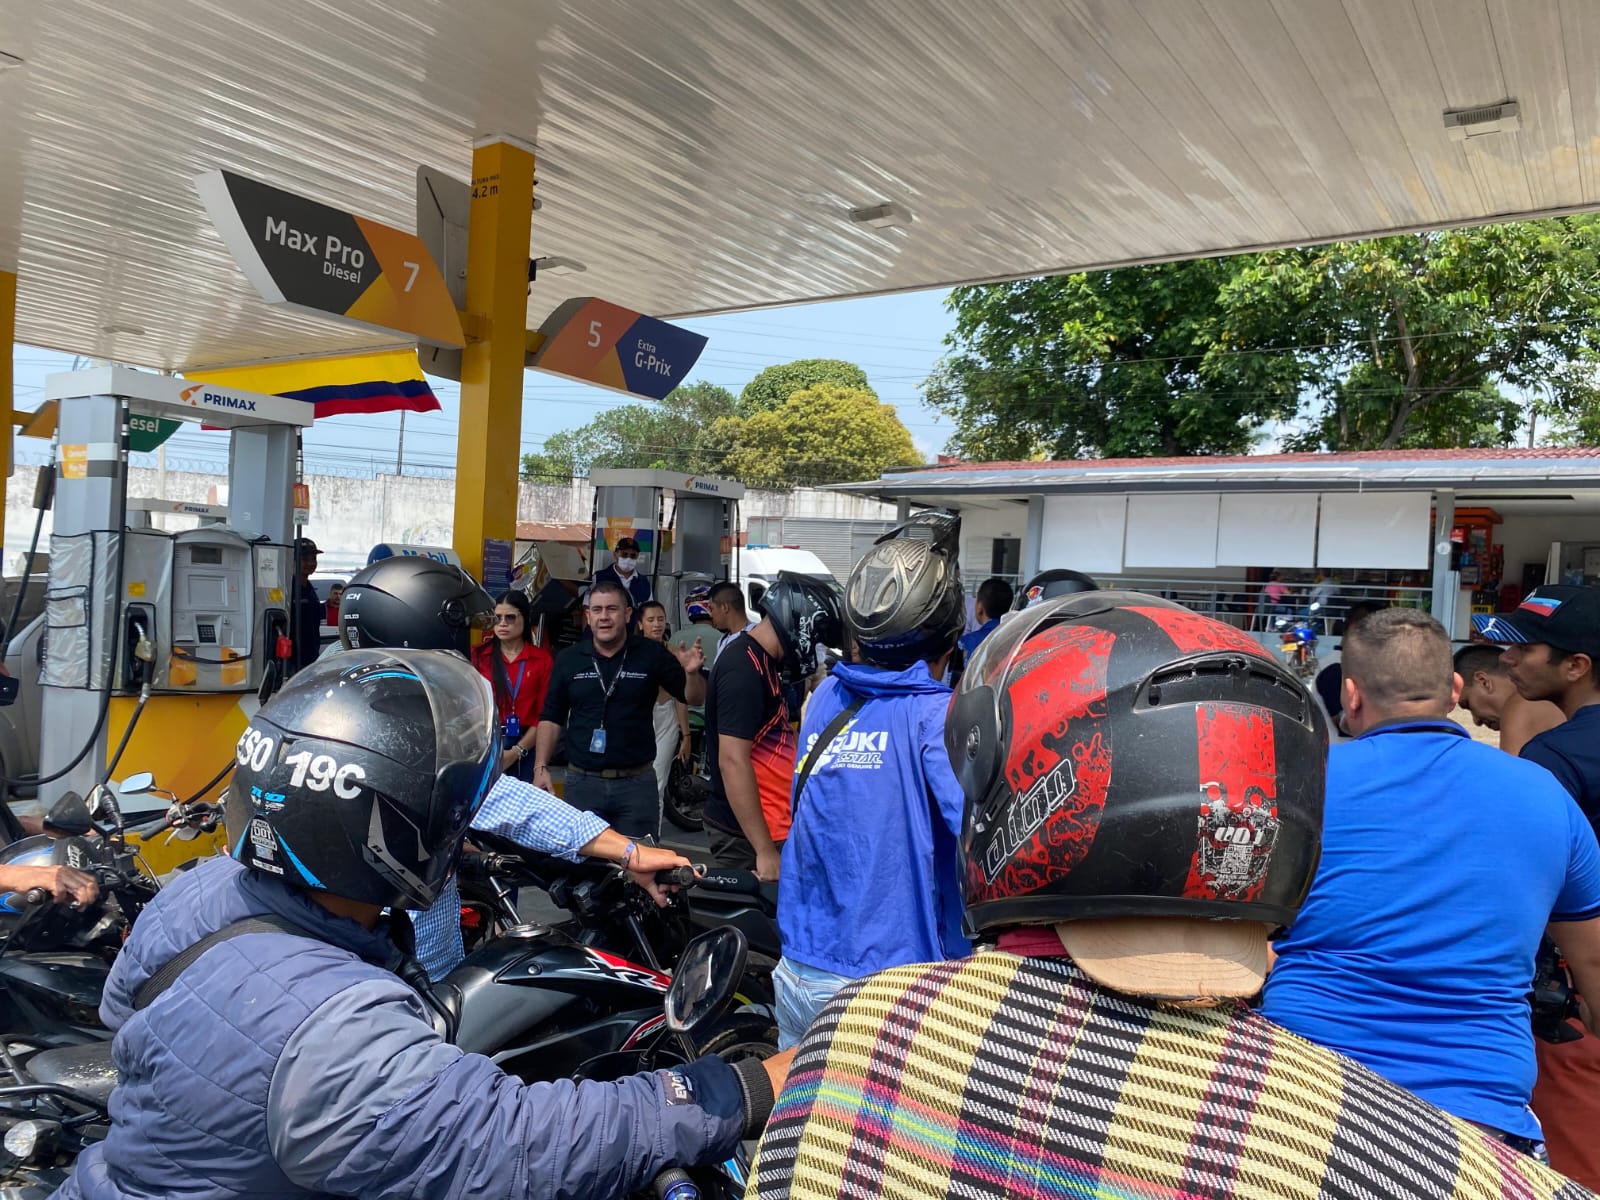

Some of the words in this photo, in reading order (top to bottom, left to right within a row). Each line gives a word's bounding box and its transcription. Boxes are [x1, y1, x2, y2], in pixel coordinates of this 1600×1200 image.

[265, 215, 318, 256] Max
[325, 235, 365, 269] Pro
[323, 261, 361, 284] Diesel
[403, 261, 420, 293] 7
[587, 320, 602, 348] 5
[637, 339, 656, 353] Extra
[635, 351, 672, 377] G-Prix
[204, 393, 256, 411] PRIMAX
[130, 417, 160, 433] esel
[695, 482, 719, 492] PRIMAX
[806, 731, 889, 755] SZUKI
[285, 750, 366, 800] 19C
